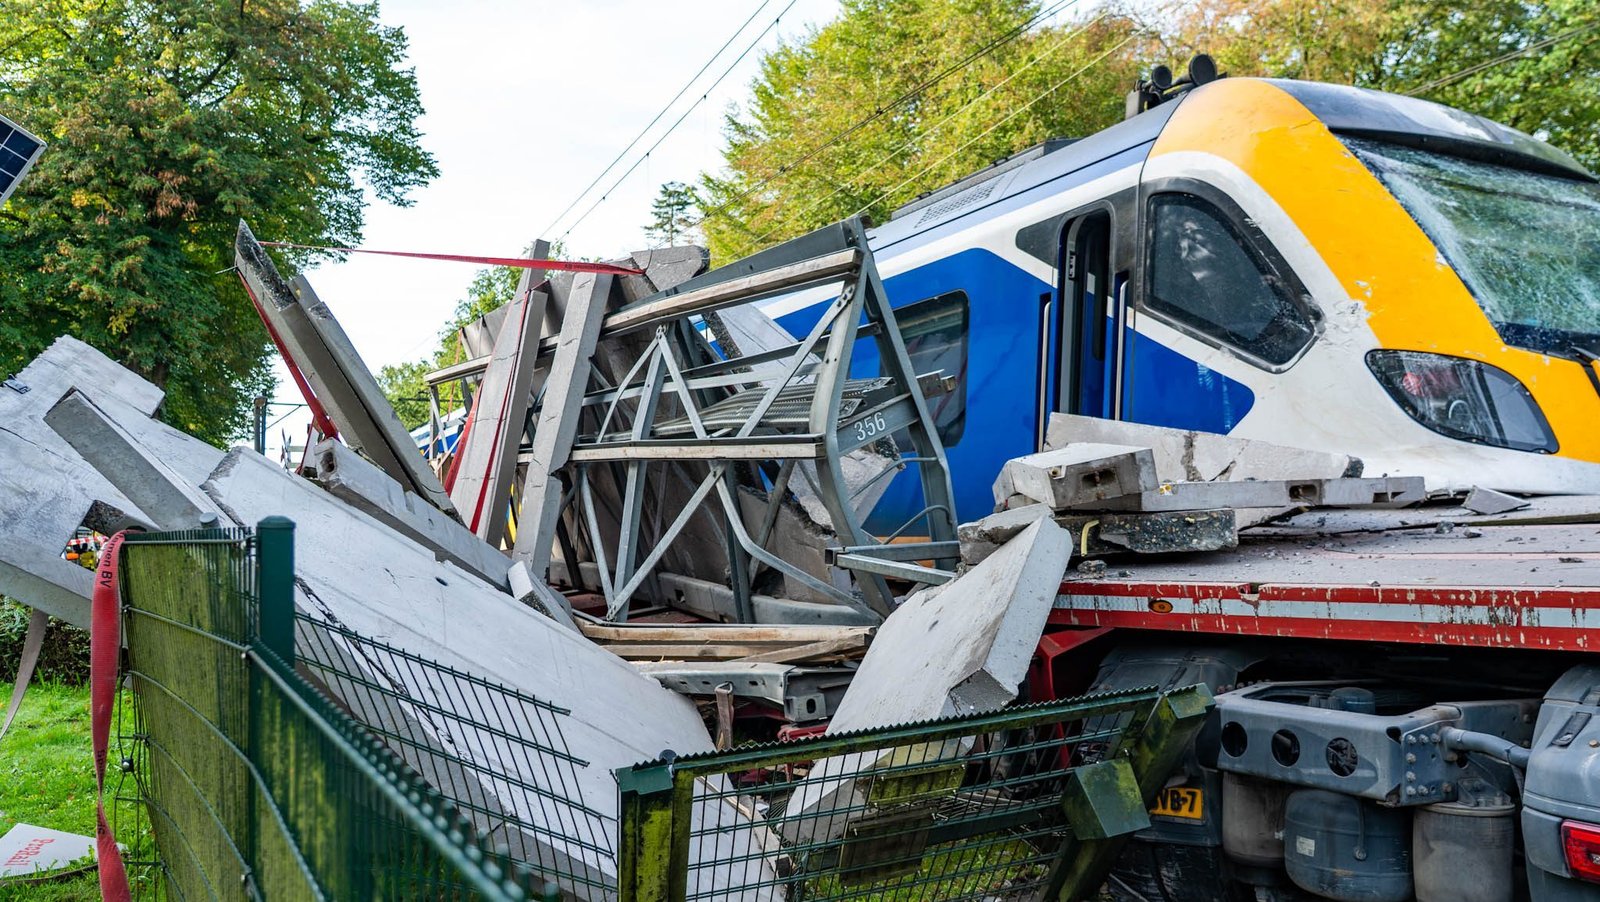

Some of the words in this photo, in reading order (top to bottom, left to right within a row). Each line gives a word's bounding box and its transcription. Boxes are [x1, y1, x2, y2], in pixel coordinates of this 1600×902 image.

[854, 411, 886, 440] 356
[100, 570, 113, 588] BV
[1152, 787, 1198, 813] VB-7
